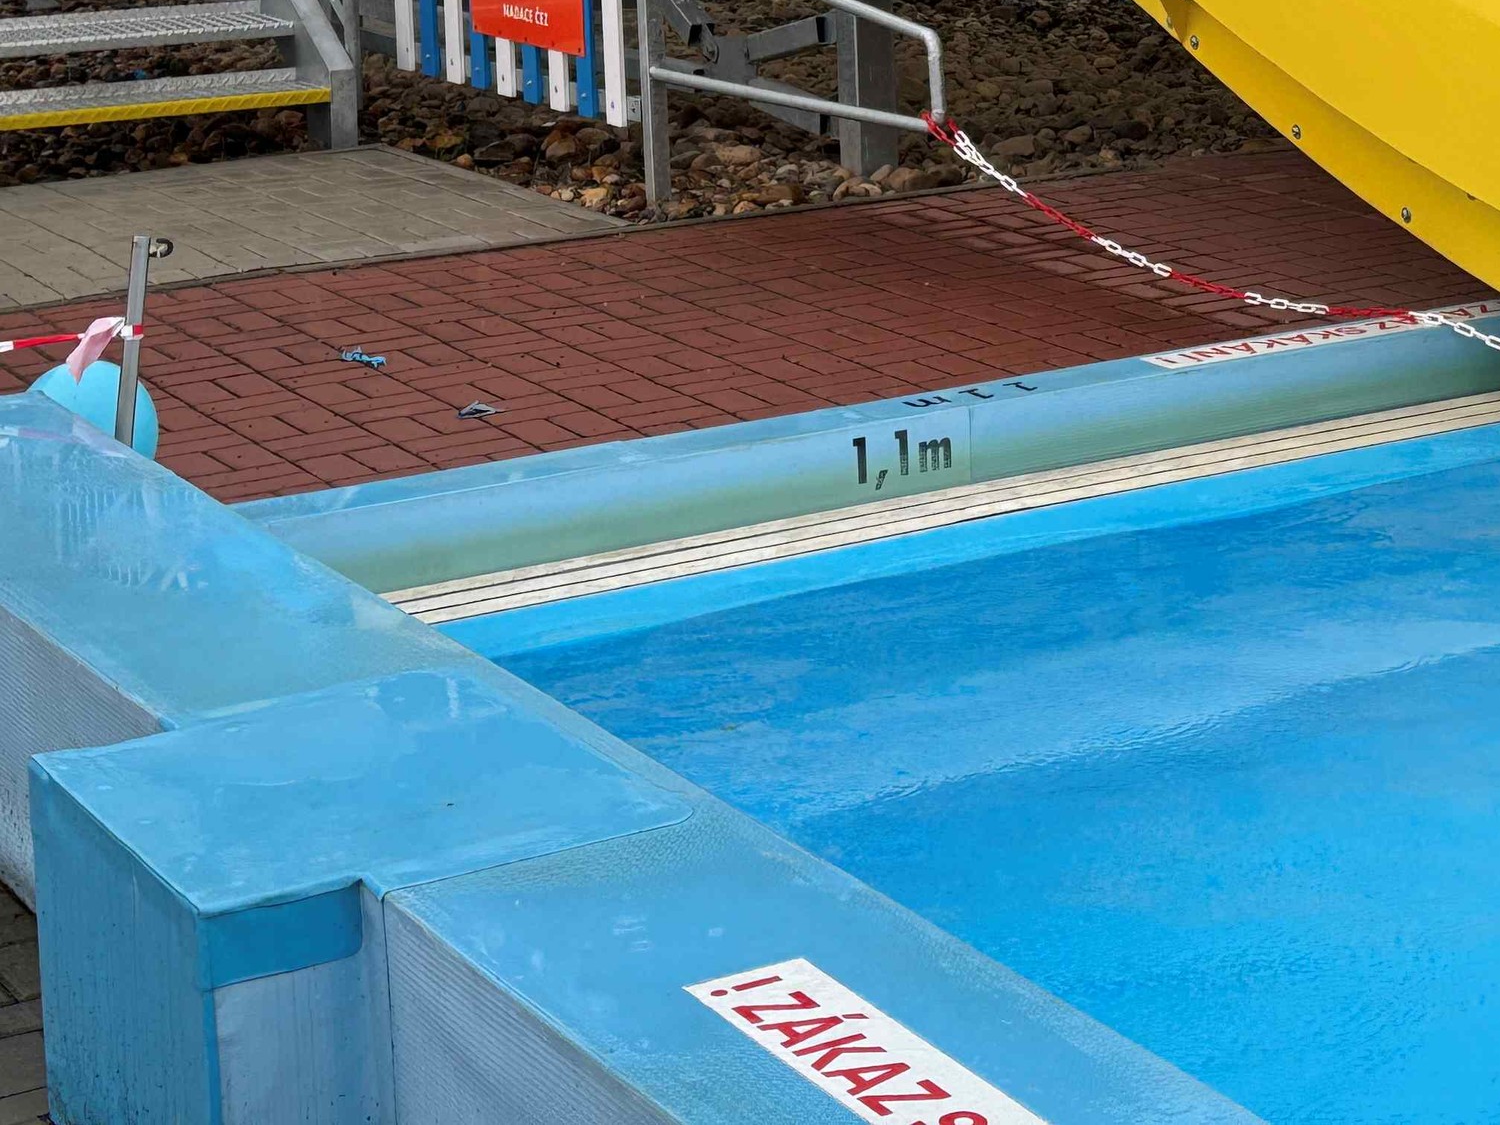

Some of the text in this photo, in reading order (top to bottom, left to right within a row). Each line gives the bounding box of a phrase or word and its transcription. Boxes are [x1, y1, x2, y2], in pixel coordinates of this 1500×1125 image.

[503, 3, 549, 26] NADACE ČEZ
[852, 429, 952, 491] 1,1m
[731, 991, 953, 1117] ZÁKAZ
